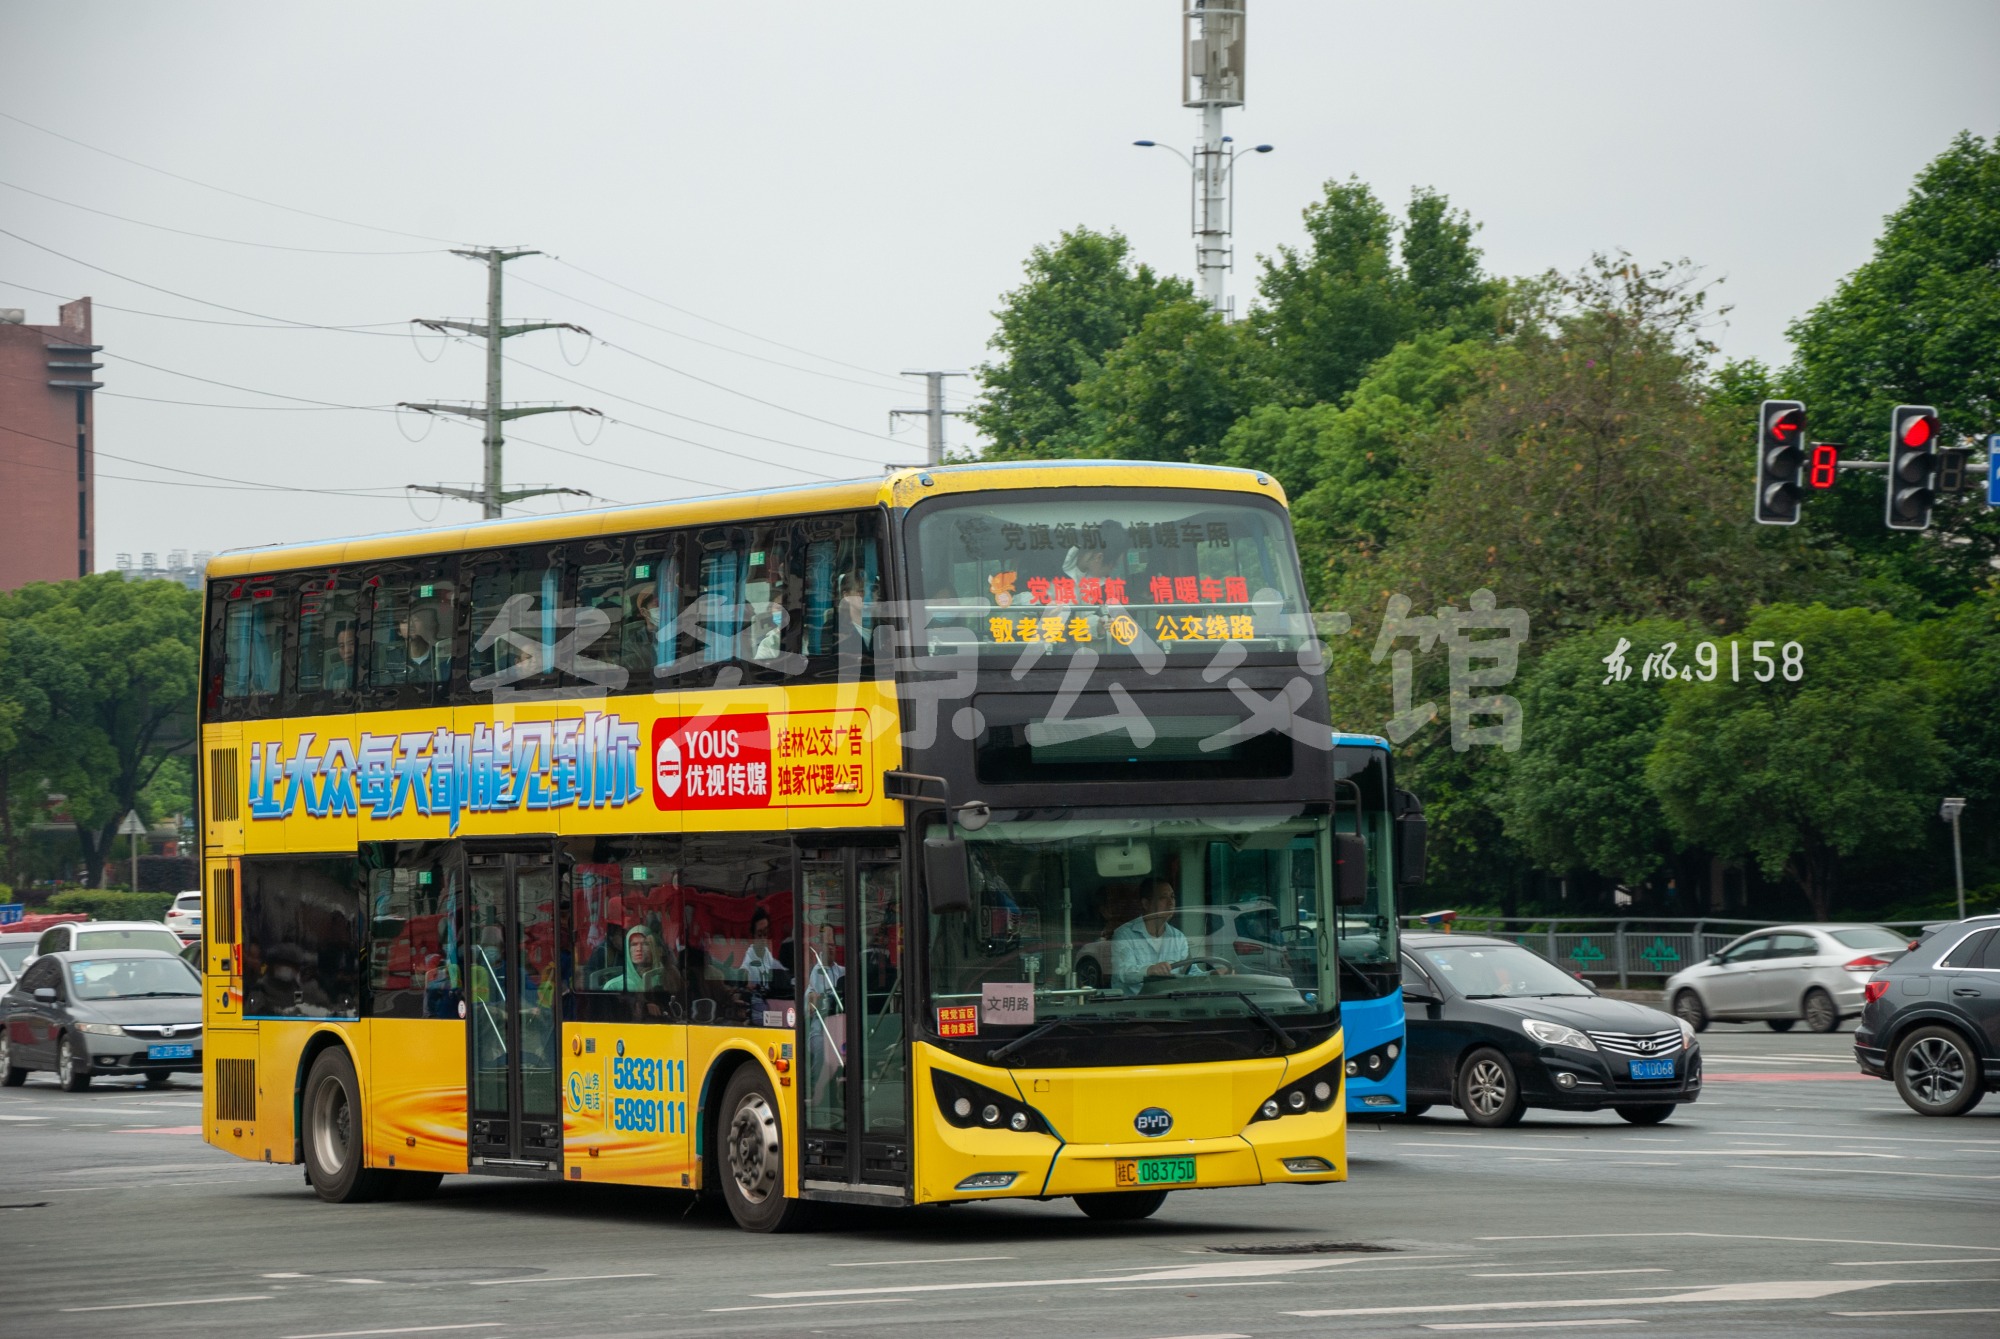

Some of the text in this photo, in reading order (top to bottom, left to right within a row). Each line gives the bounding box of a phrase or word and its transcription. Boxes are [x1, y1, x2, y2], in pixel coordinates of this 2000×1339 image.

[1810, 445, 1838, 489] 8
[1027, 576, 1249, 605] 党旗领航 情暖车厢
[989, 617, 1093, 643] 敬老爱老
[1115, 620, 1134, 641] BUS
[1155, 615, 1255, 641] 公交线路
[685, 729, 739, 759] YOUS
[777, 724, 863, 758] 桂林公交广告
[248, 711, 643, 835] 让大众每天都能见到你
[685, 762, 767, 797] 优视传媒
[777, 764, 863, 796] 独家代理公司
[940, 1009, 975, 1020] 视觉盲区
[987, 997, 1029, 1012] 文明路
[941, 1023, 975, 1035] 请勿靠近
[613, 1057, 685, 1093] 5833111
[614, 1098, 686, 1134] 5899111
[1138, 1115, 1169, 1129] BYD
